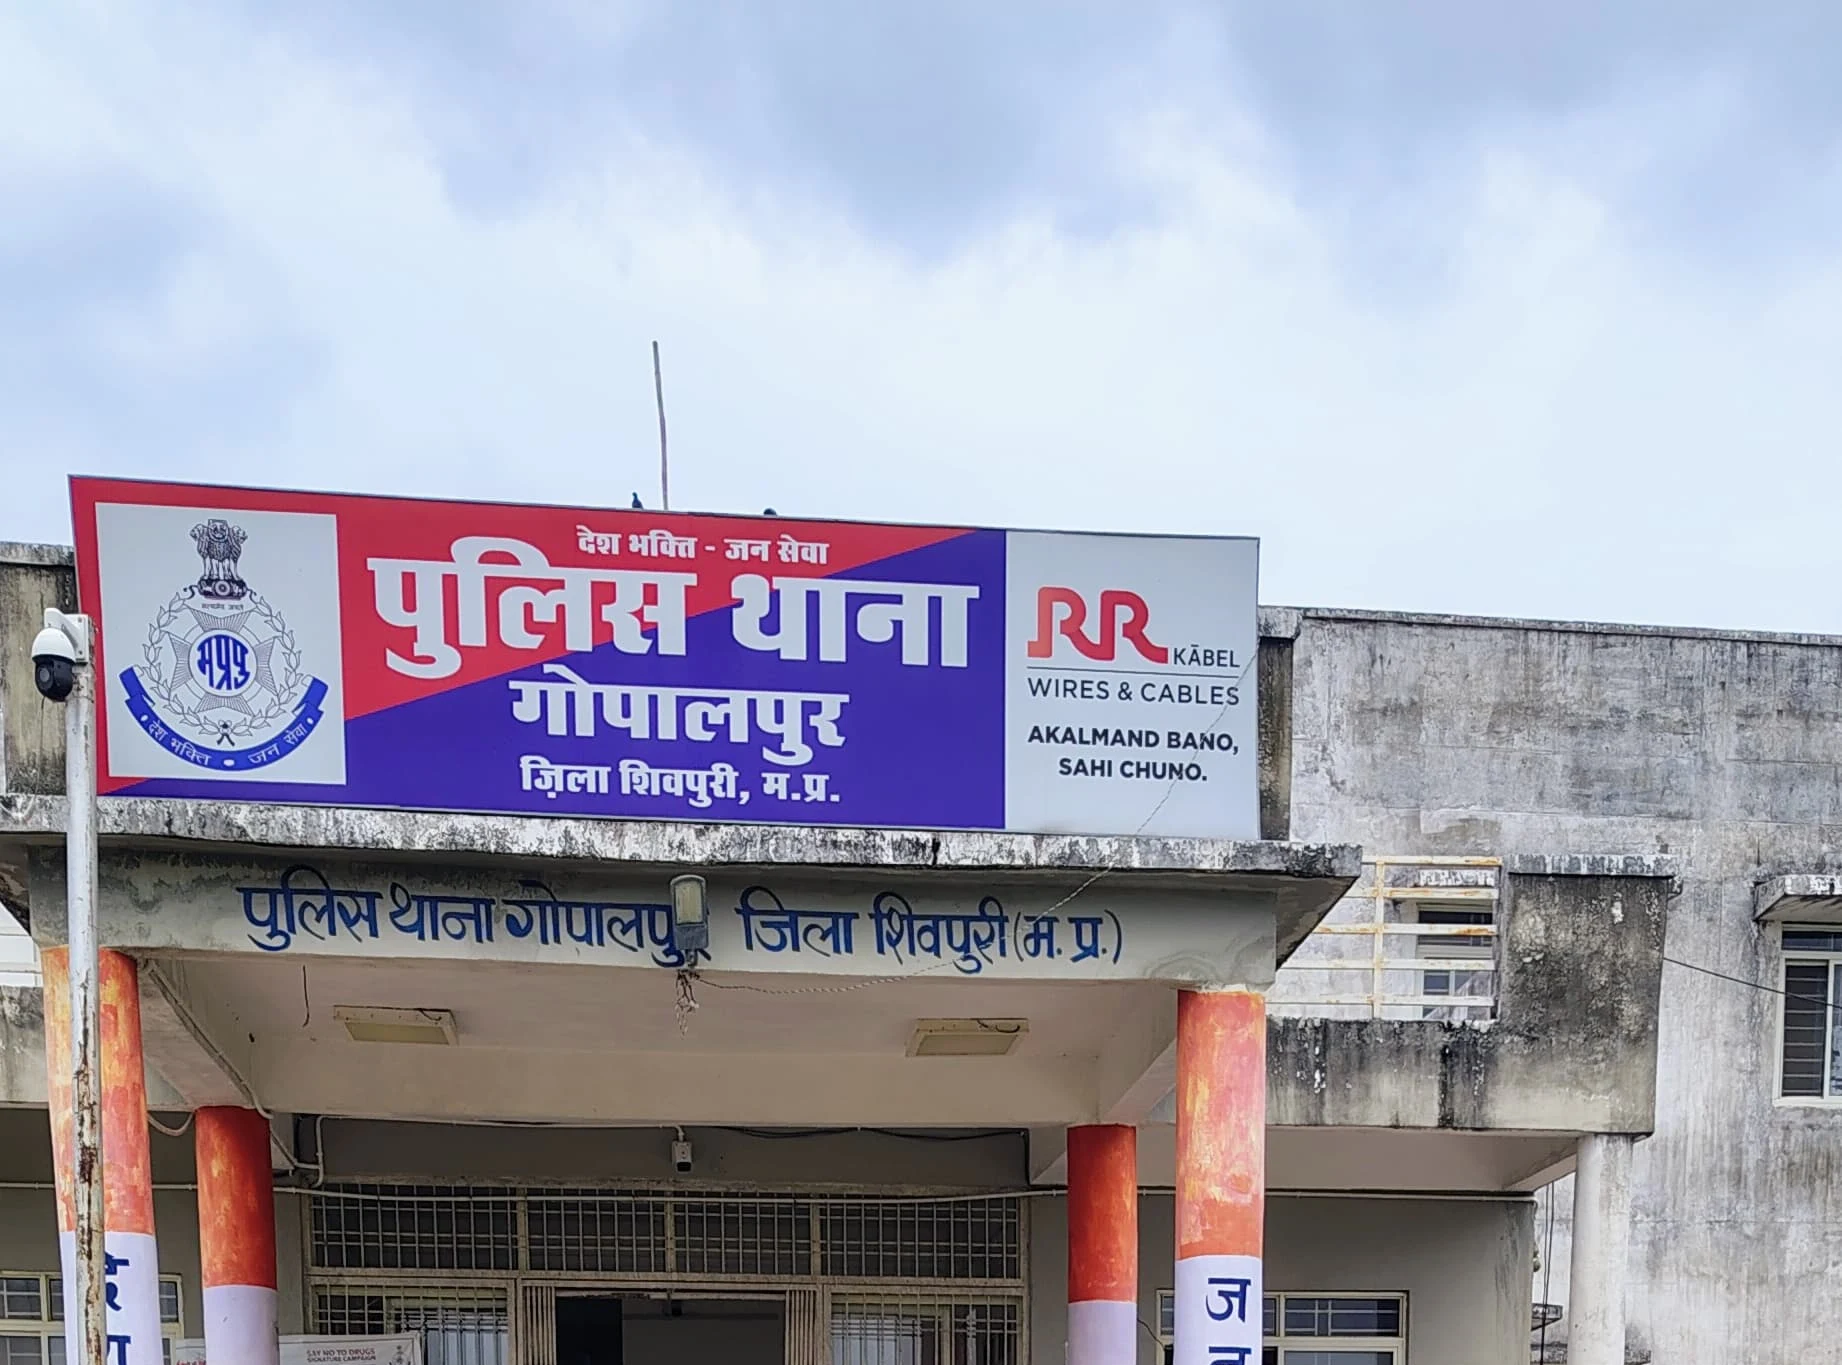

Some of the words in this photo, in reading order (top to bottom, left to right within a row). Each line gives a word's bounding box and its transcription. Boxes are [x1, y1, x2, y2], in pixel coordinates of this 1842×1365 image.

[576, 525, 619, 555] देश
[628, 529, 697, 560] भक्ति
[724, 538, 768, 563] जन
[778, 535, 829, 565] सेवा
[367, 535, 697, 679] पुलिस
[731, 573, 980, 668] थाना
[1027, 586, 1169, 665] RR
[1027, 677, 1109, 701] WIRES
[1117, 681, 1133, 702] &
[1140, 682, 1240, 706] CABLES
[508, 664, 850, 766] गोपालपुर
[148, 719, 169, 742] देश
[170, 737, 212, 767] भक्ति
[248, 743, 281, 765] जन
[283, 722, 308, 745] सेवा
[1027, 725, 1160, 751] AKALMAND
[1167, 730, 1239, 756] BANO,
[519, 754, 610, 799] ज़िला
[620, 758, 750, 808] शिवपुरी,
[762, 770, 841, 803] म.प्र.
[1058, 757, 1113, 780] SAHI
[1119, 759, 1208, 783] CHUNO.
[236, 864, 383, 952] पुलिस
[390, 881, 496, 943] थाना
[502, 879, 711, 969] गोपालपु
[734, 885, 859, 957] जिला
[869, 891, 1008, 975] शिवपुरी
[349, 1348, 377, 1356] DRUGS
